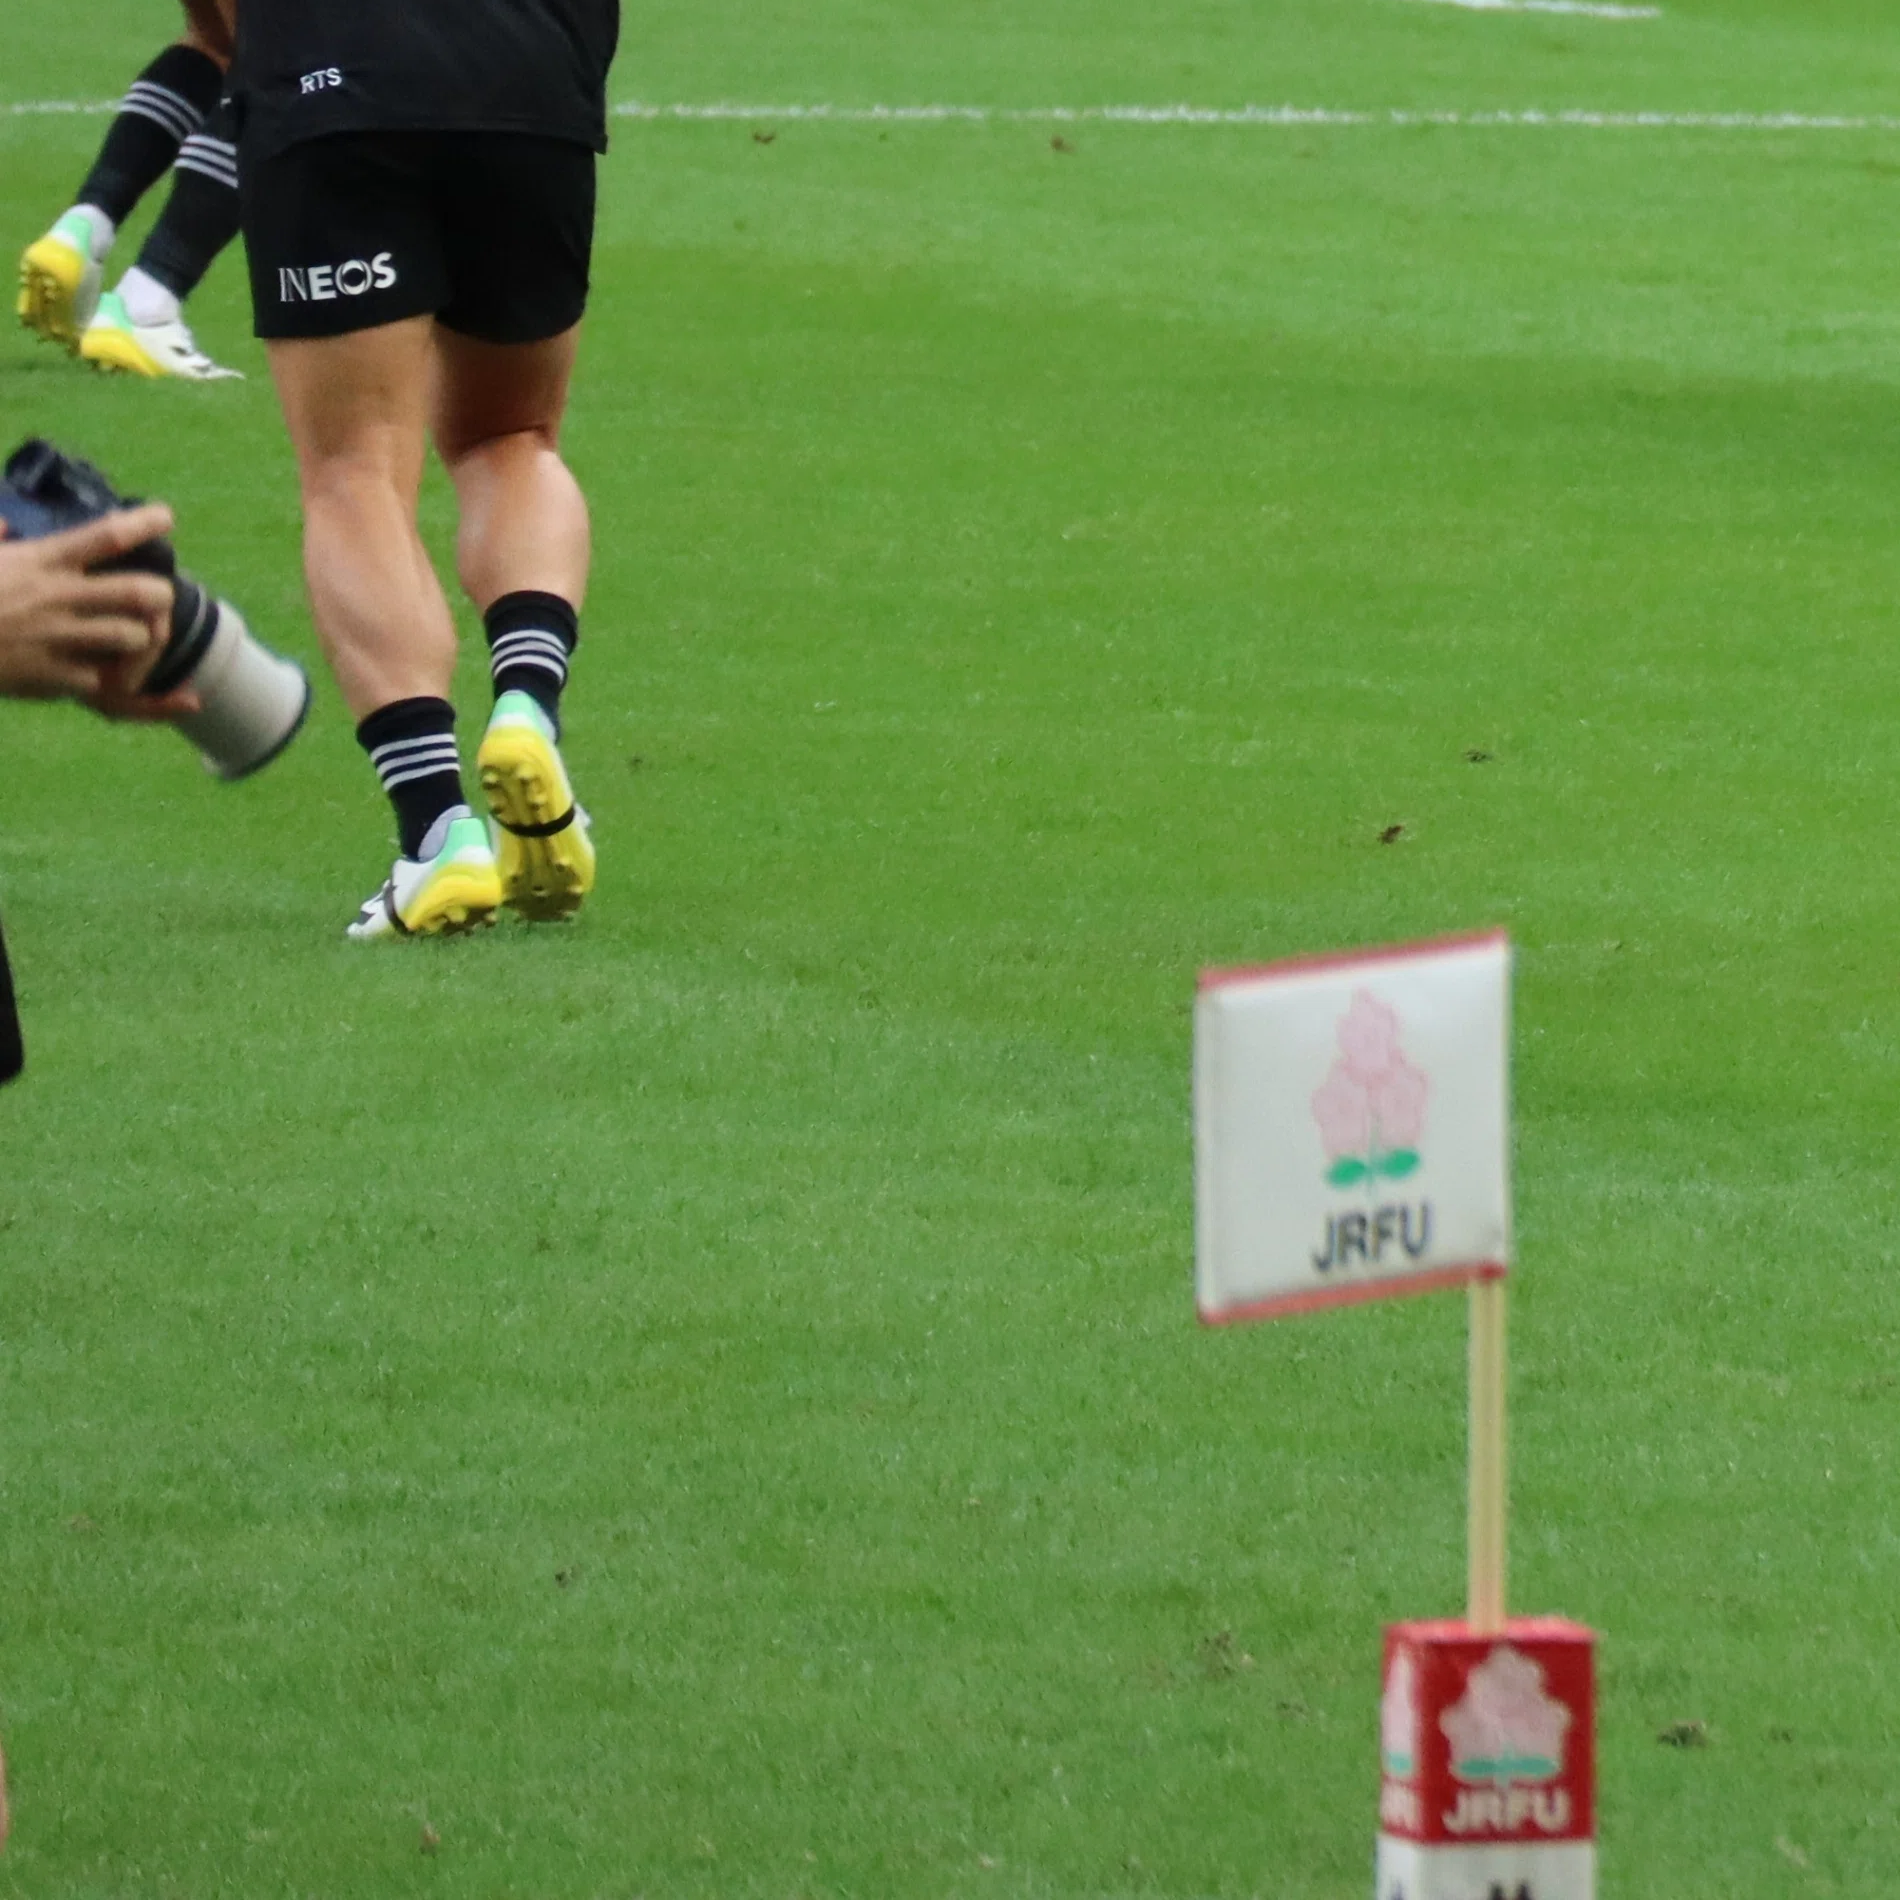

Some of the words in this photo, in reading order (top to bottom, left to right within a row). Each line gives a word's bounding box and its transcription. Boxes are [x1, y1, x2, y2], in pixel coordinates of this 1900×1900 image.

[300, 67, 343, 94] RTS
[279, 252, 397, 302] INEOS
[1312, 1203, 1432, 1275] JRFU
[1442, 1786, 1573, 1836] JRFU
